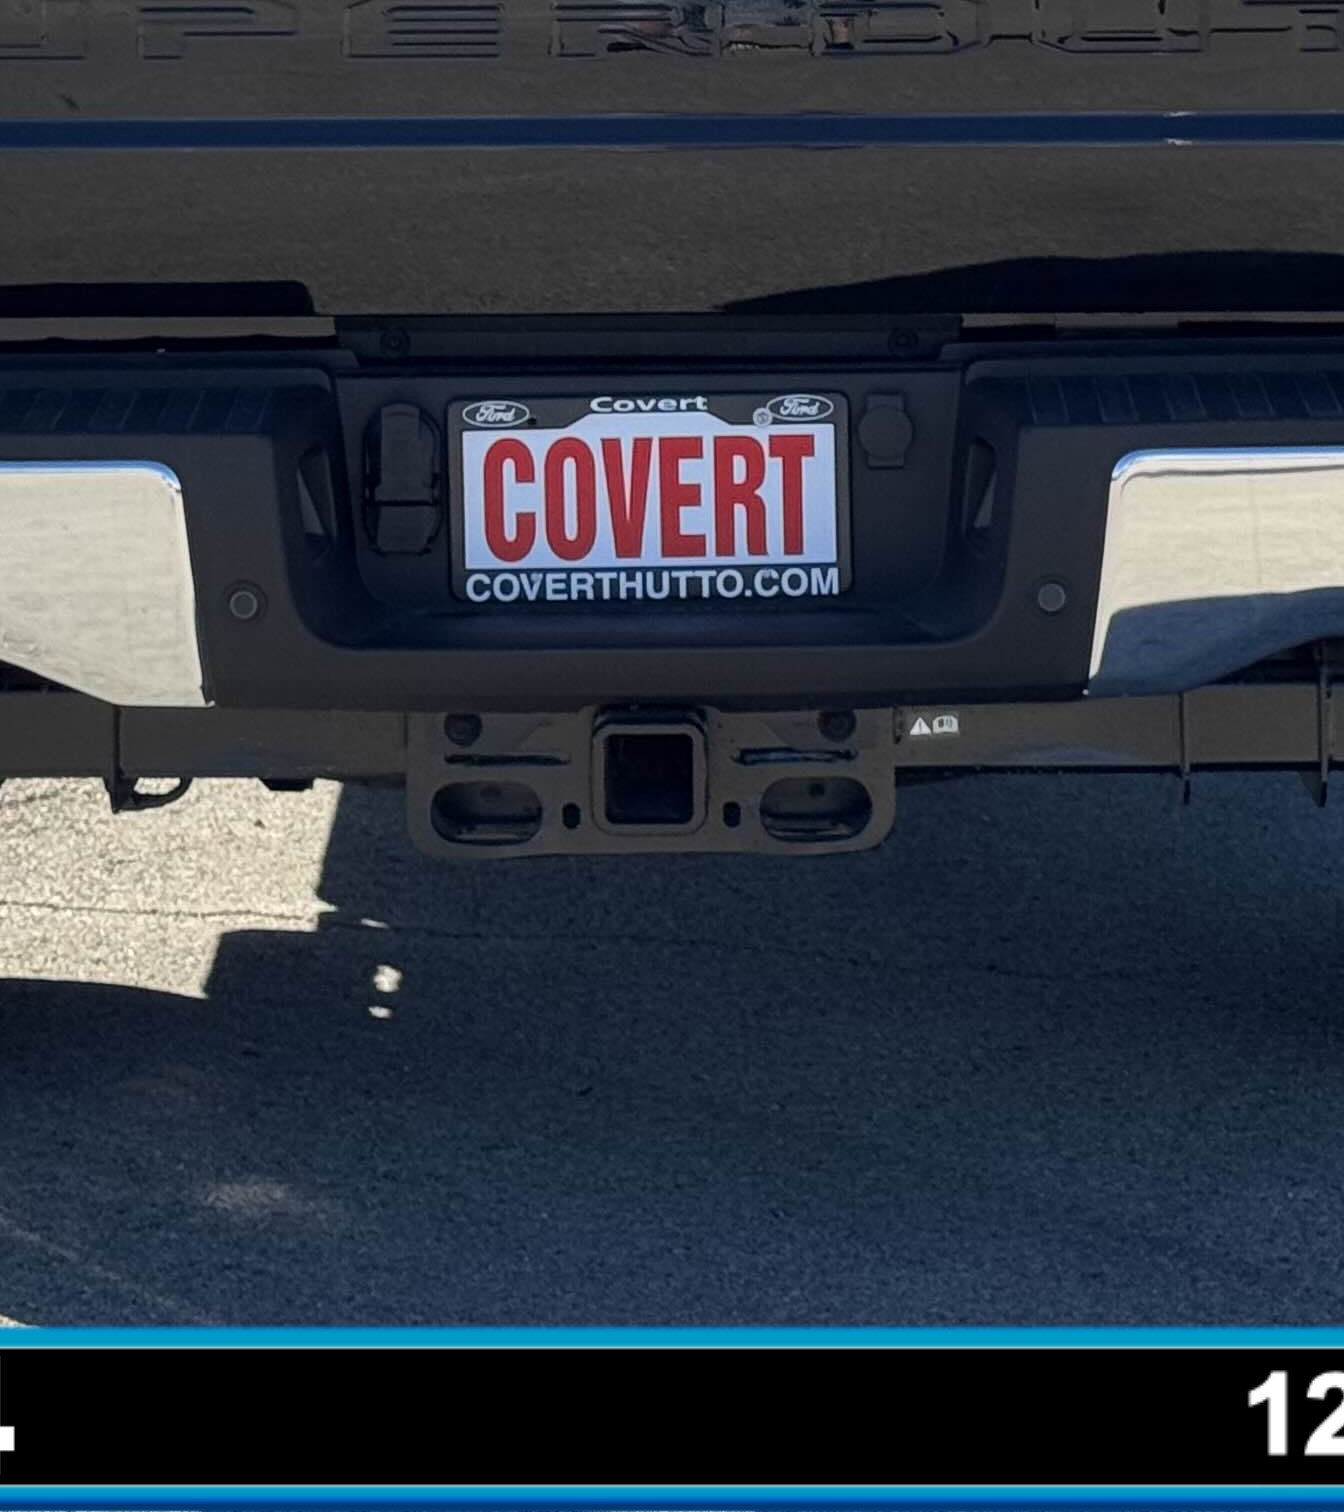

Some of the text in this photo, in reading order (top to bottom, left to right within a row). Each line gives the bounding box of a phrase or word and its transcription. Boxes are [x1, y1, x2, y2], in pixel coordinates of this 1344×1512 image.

[476, 404, 516, 422] Ford
[590, 395, 709, 413] Covert
[780, 398, 821, 416] Ford
[482, 433, 816, 563] COVERT
[465, 567, 841, 603] COVERTHUTTO.COM
